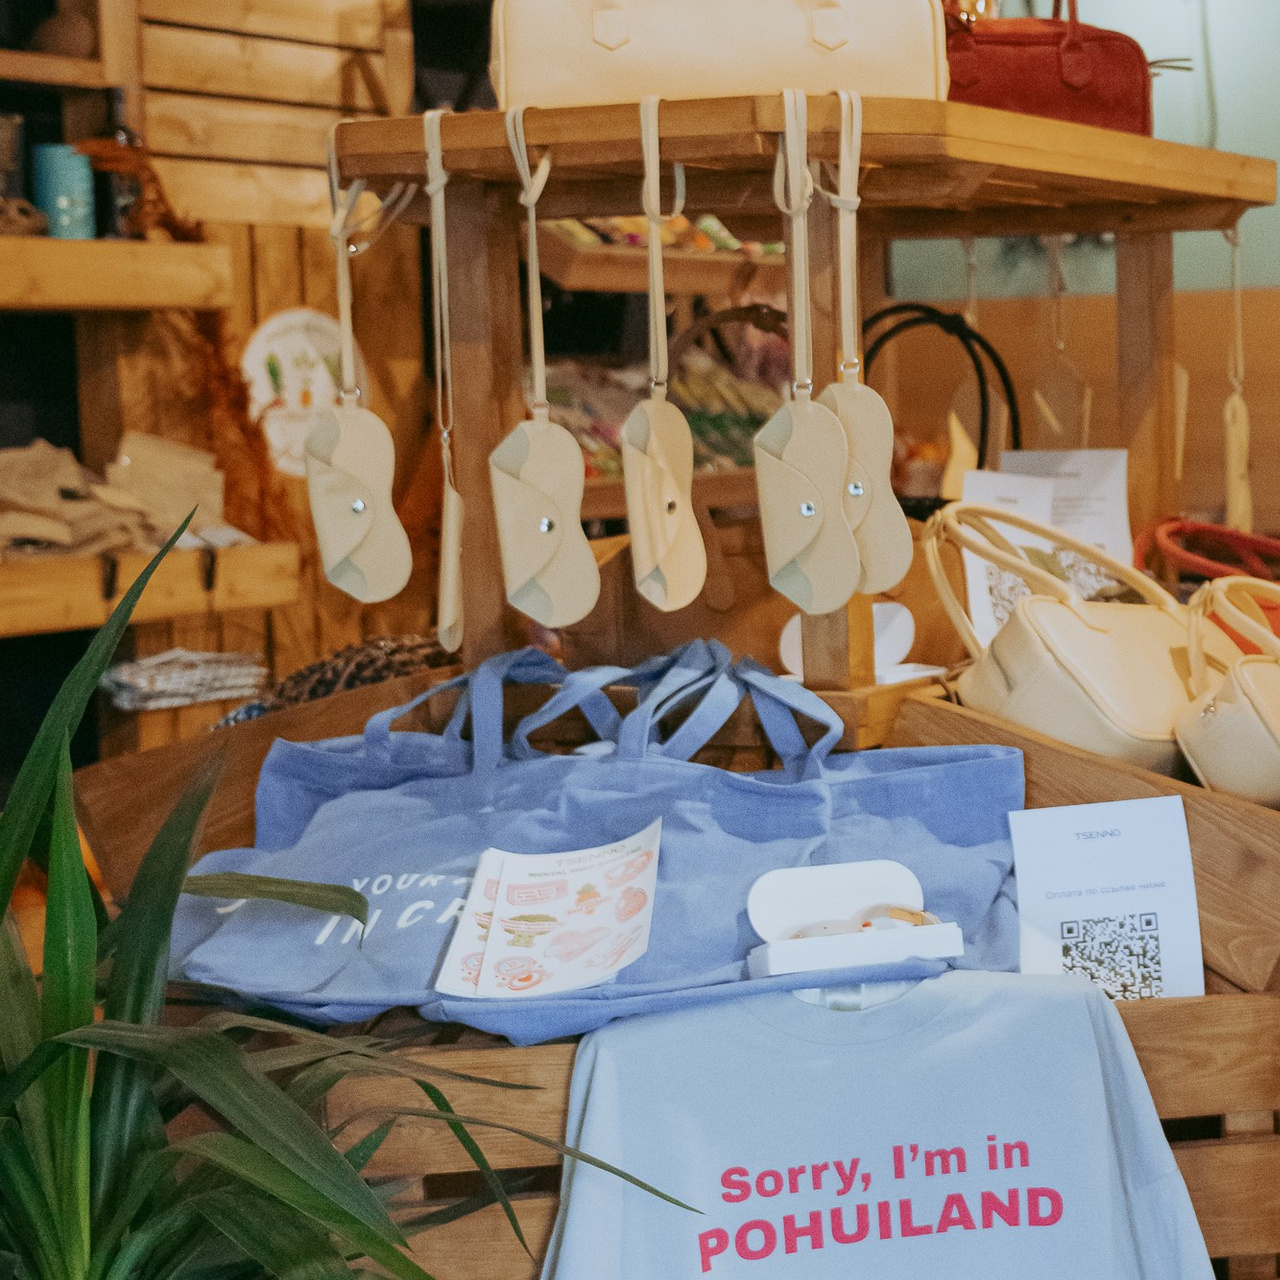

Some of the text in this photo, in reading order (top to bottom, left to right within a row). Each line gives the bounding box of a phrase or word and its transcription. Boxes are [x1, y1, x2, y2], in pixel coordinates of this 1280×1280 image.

[1075, 828, 1122, 840] TSENNO
[1045, 889, 1083, 900] Оплата
[1085, 887, 1099, 896] по
[1101, 883, 1137, 894] ссылке
[720, 1134, 1030, 1204] Sorry, I'm in
[698, 1186, 1064, 1274] POHUILAND
